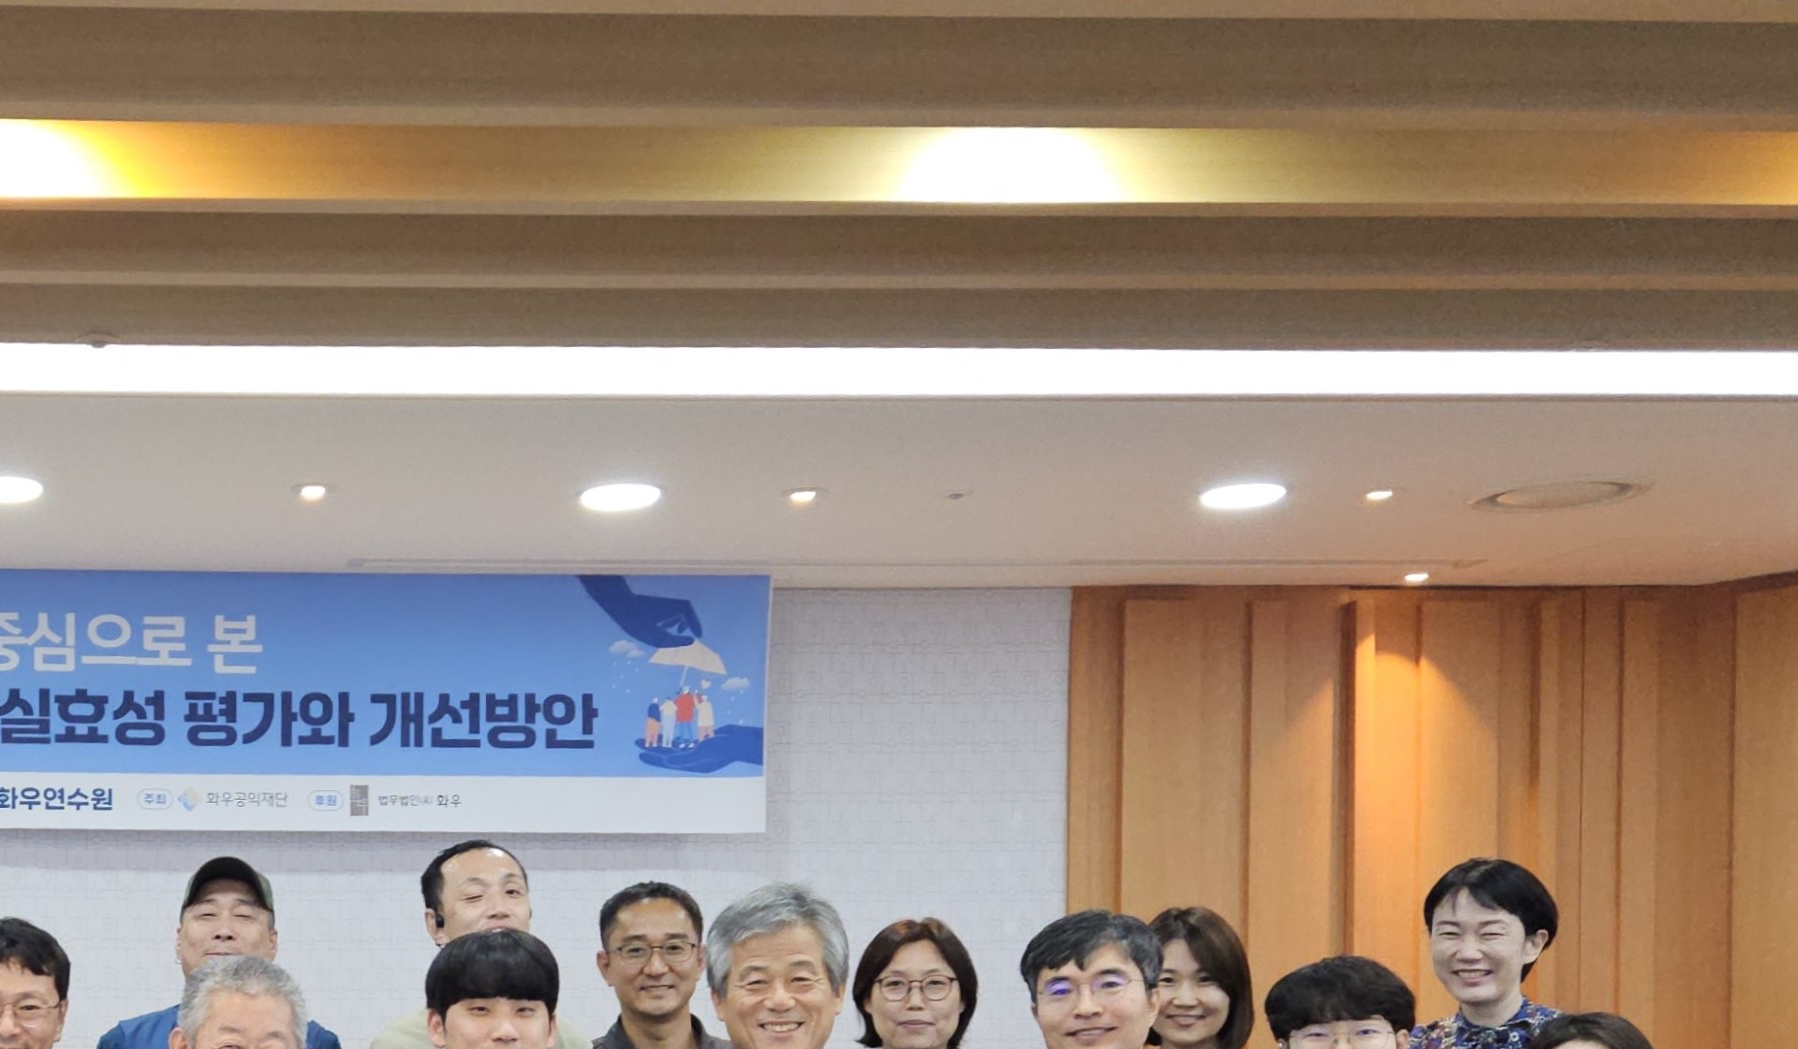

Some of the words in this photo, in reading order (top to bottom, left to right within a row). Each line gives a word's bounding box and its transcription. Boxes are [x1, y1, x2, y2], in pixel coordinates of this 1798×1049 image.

[207, 614, 263, 675] 본
[183, 691, 355, 747] 평가와
[369, 692, 599, 749] 개선방안
[206, 792, 289, 808] 화우공익재단
[437, 793, 463, 809] 화우
